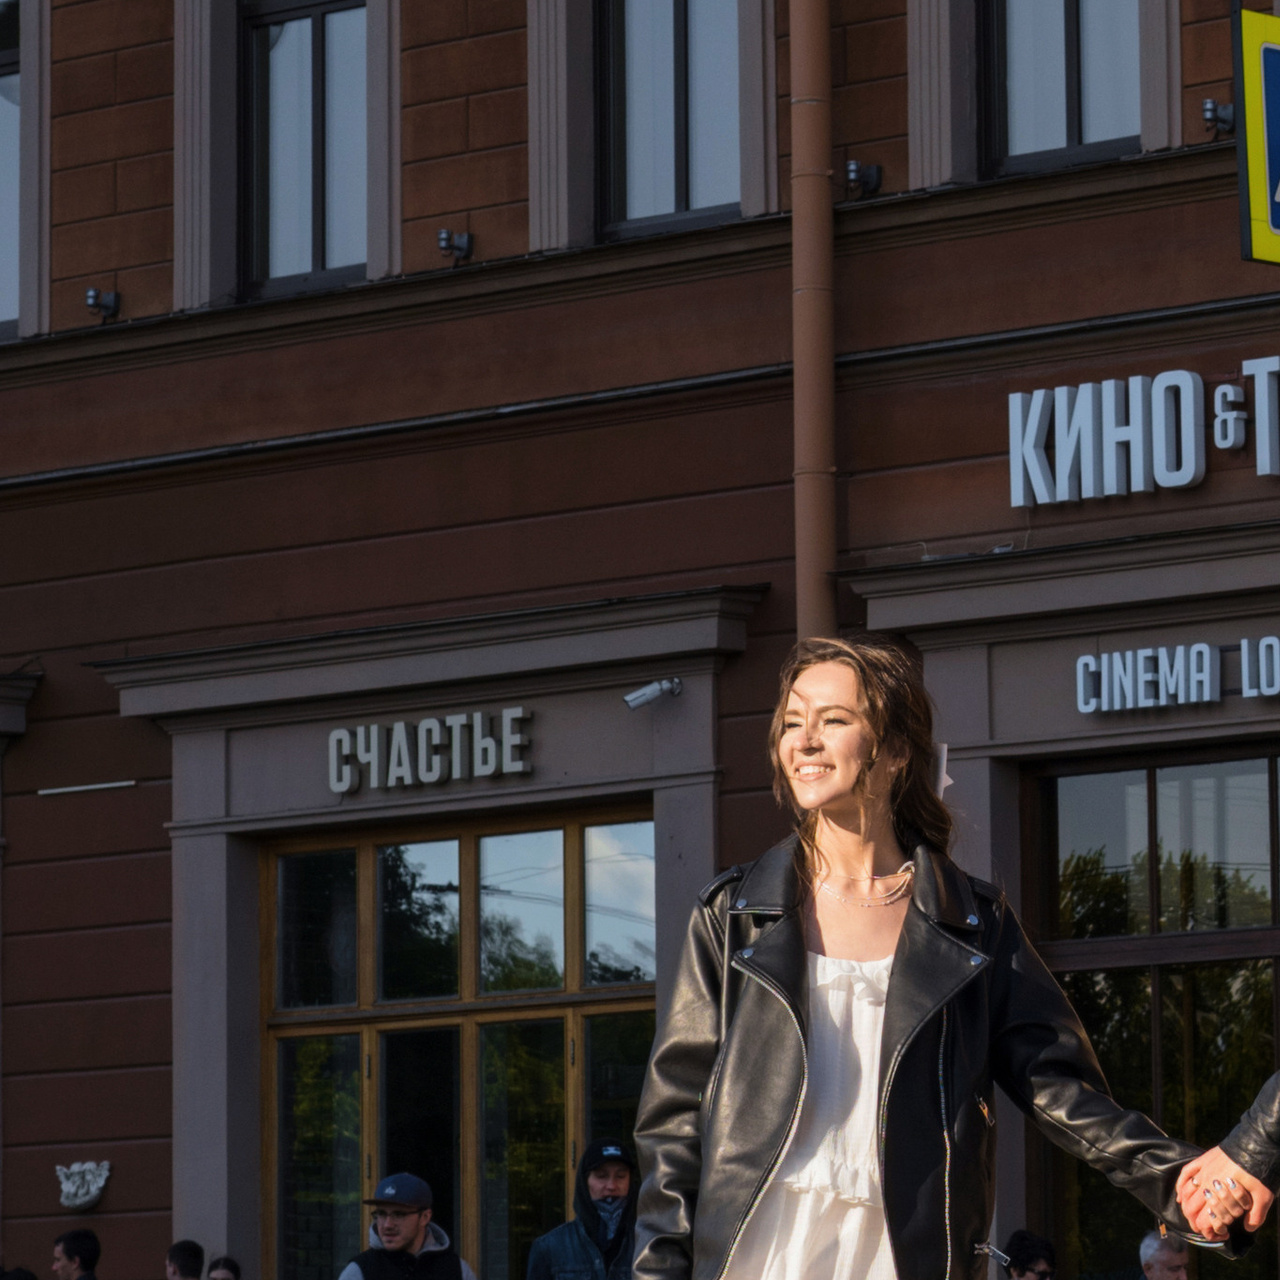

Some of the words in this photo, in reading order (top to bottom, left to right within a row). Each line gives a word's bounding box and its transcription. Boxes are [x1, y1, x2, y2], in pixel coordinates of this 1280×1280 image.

[1008, 369, 1206, 508] КИНО
[1076, 642, 1221, 714] CINEMA
[327, 706, 532, 794] СЧАСТЬЕ
